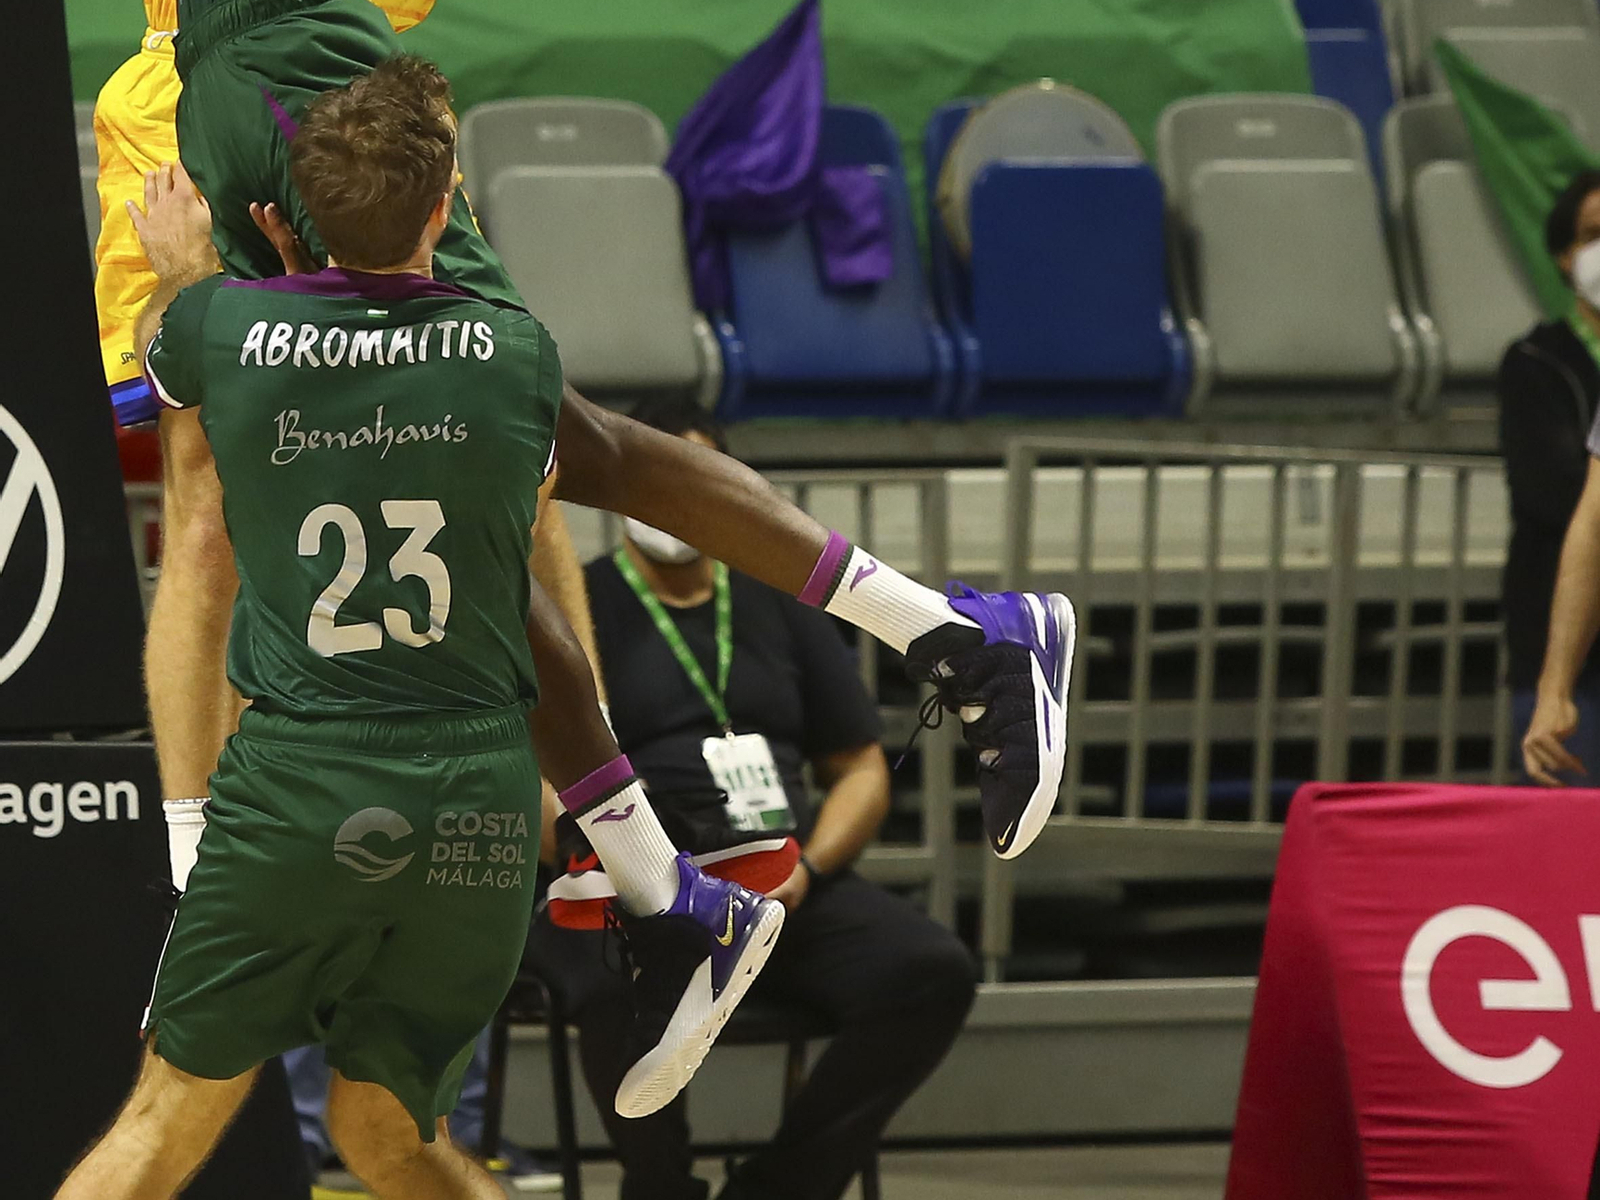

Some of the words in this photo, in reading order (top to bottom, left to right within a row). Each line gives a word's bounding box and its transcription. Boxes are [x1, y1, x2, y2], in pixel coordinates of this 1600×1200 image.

[239, 320, 495, 368] ABROMAITIS
[297, 499, 452, 658] 23
[0, 780, 140, 838] agen
[435, 810, 528, 838] COSTA
[430, 841, 481, 862] DEL
[486, 842, 526, 865] SOL
[426, 863, 523, 889] MÁLAGA
